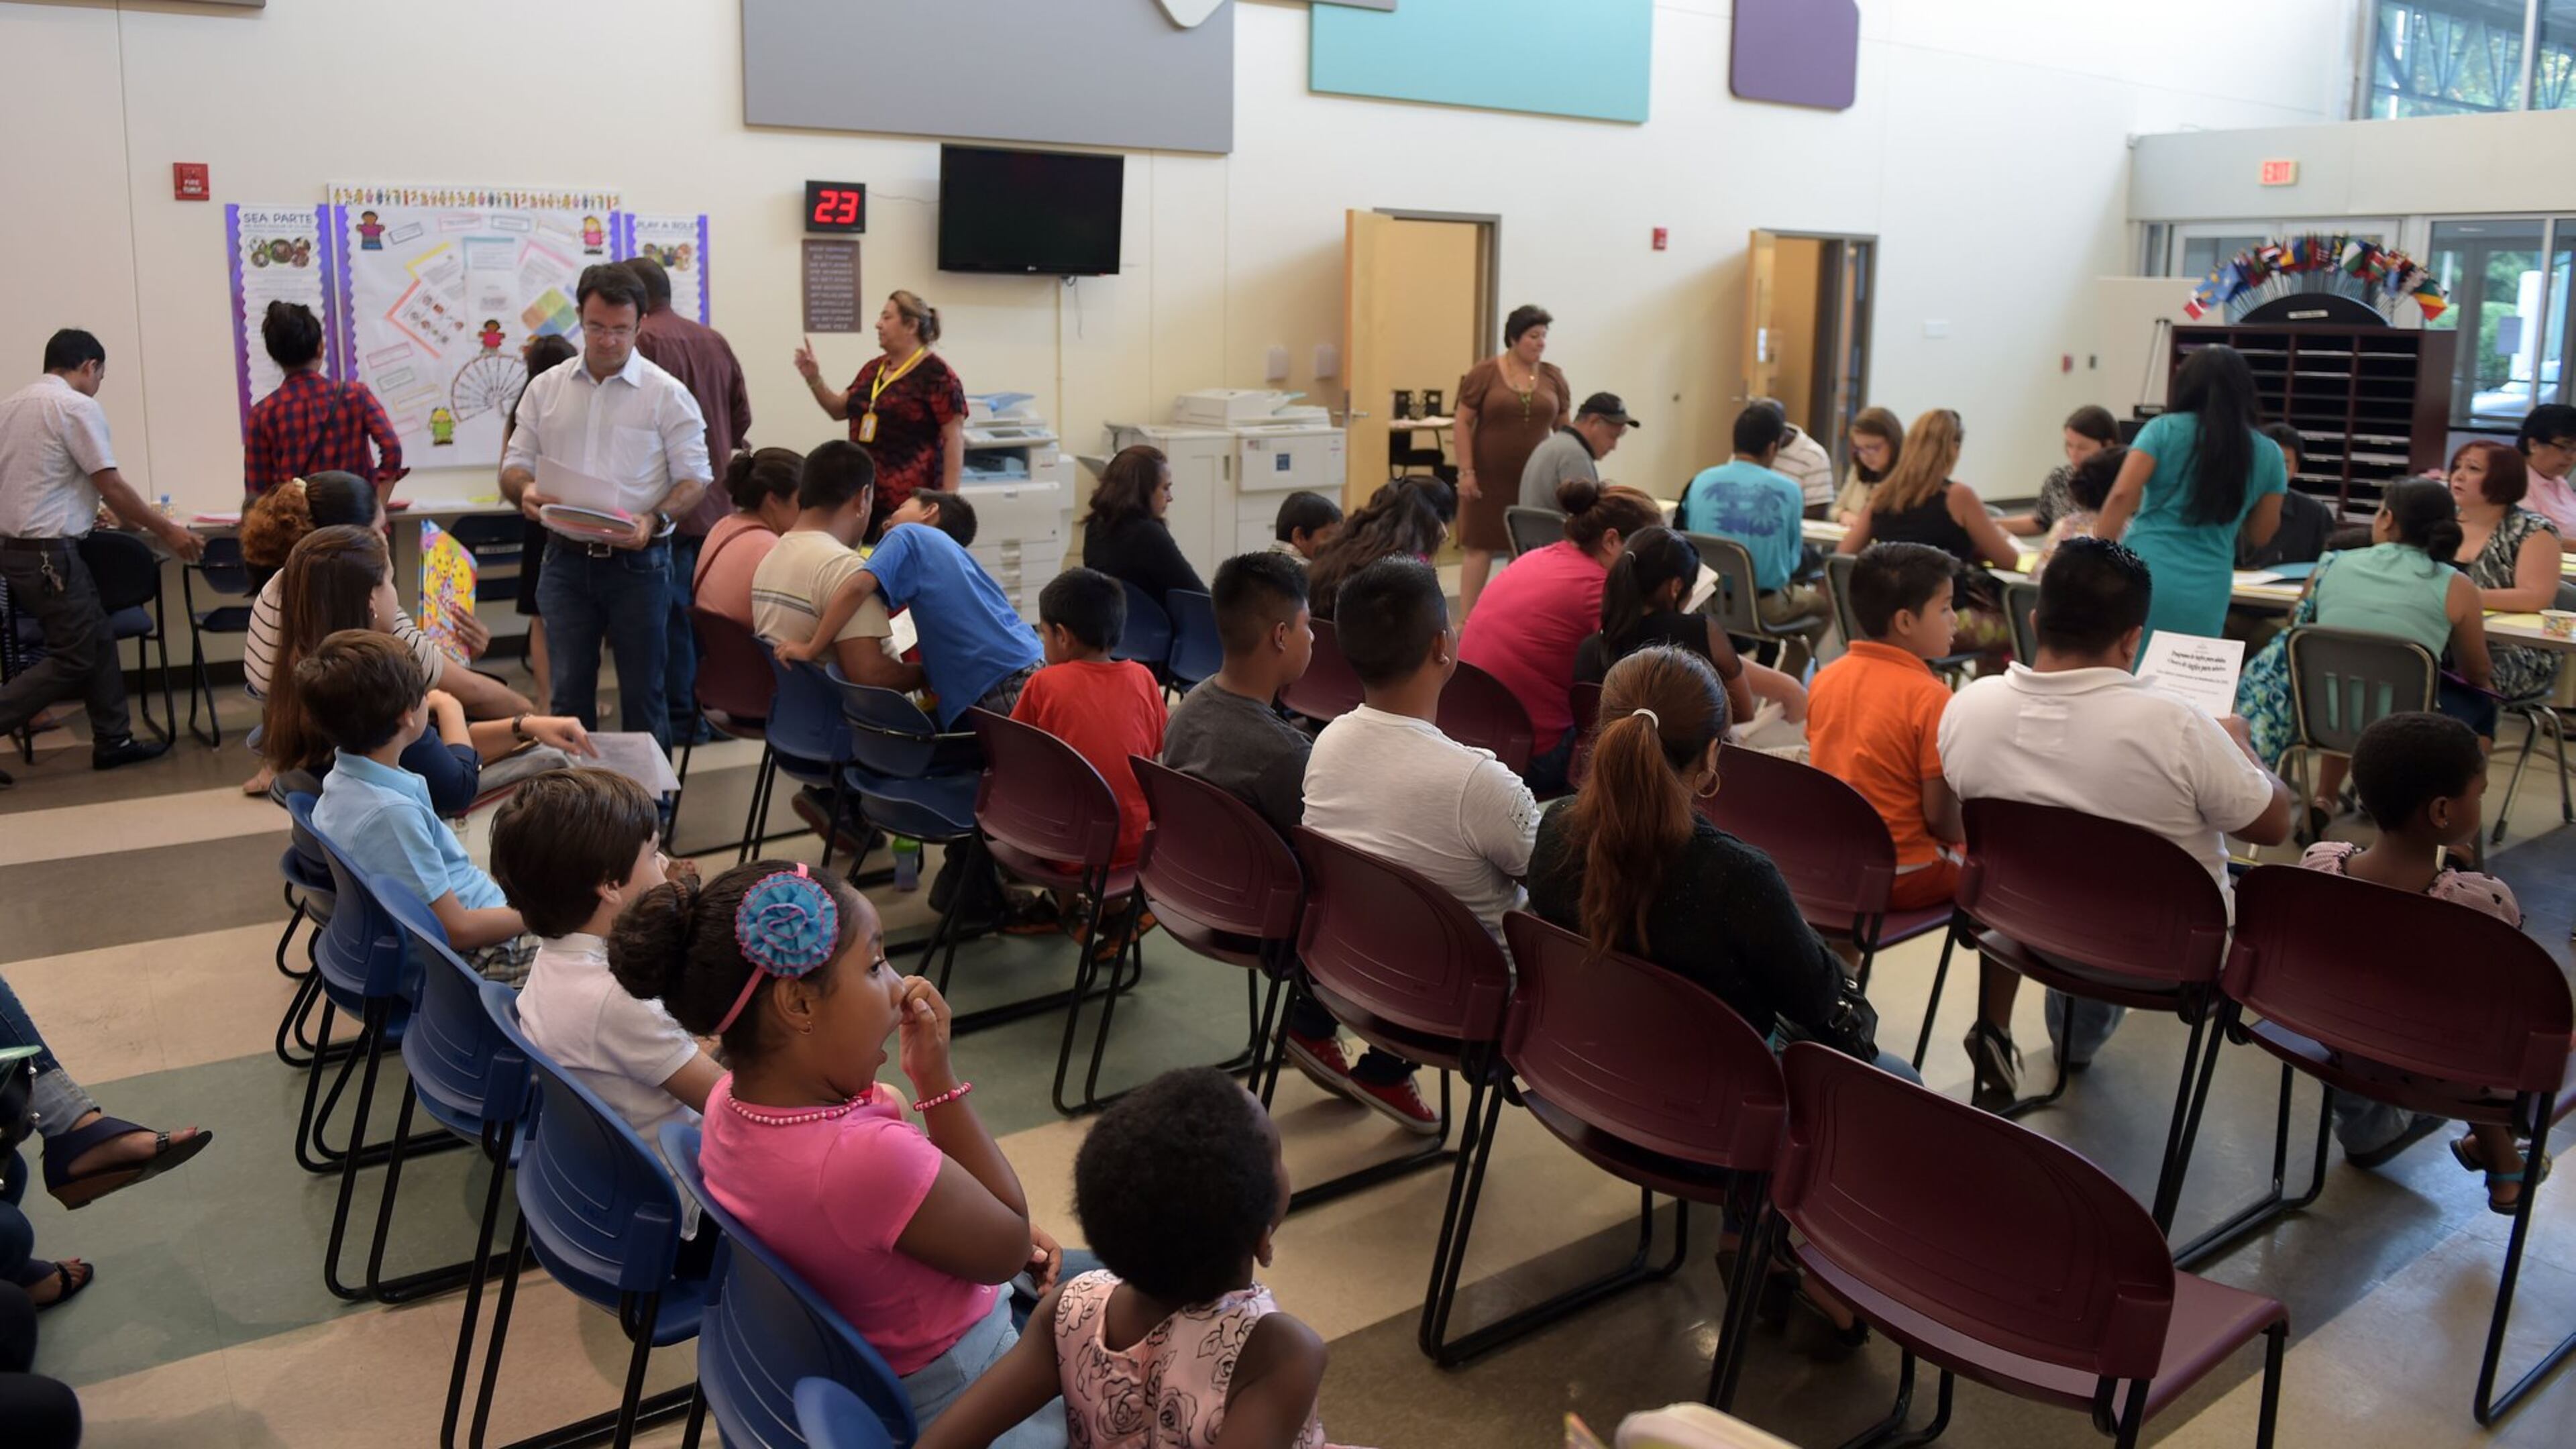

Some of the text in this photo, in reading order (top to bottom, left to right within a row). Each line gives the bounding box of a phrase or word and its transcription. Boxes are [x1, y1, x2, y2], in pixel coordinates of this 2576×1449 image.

[814, 189, 859, 224] 23
[244, 213, 312, 223] SEA PARTE
